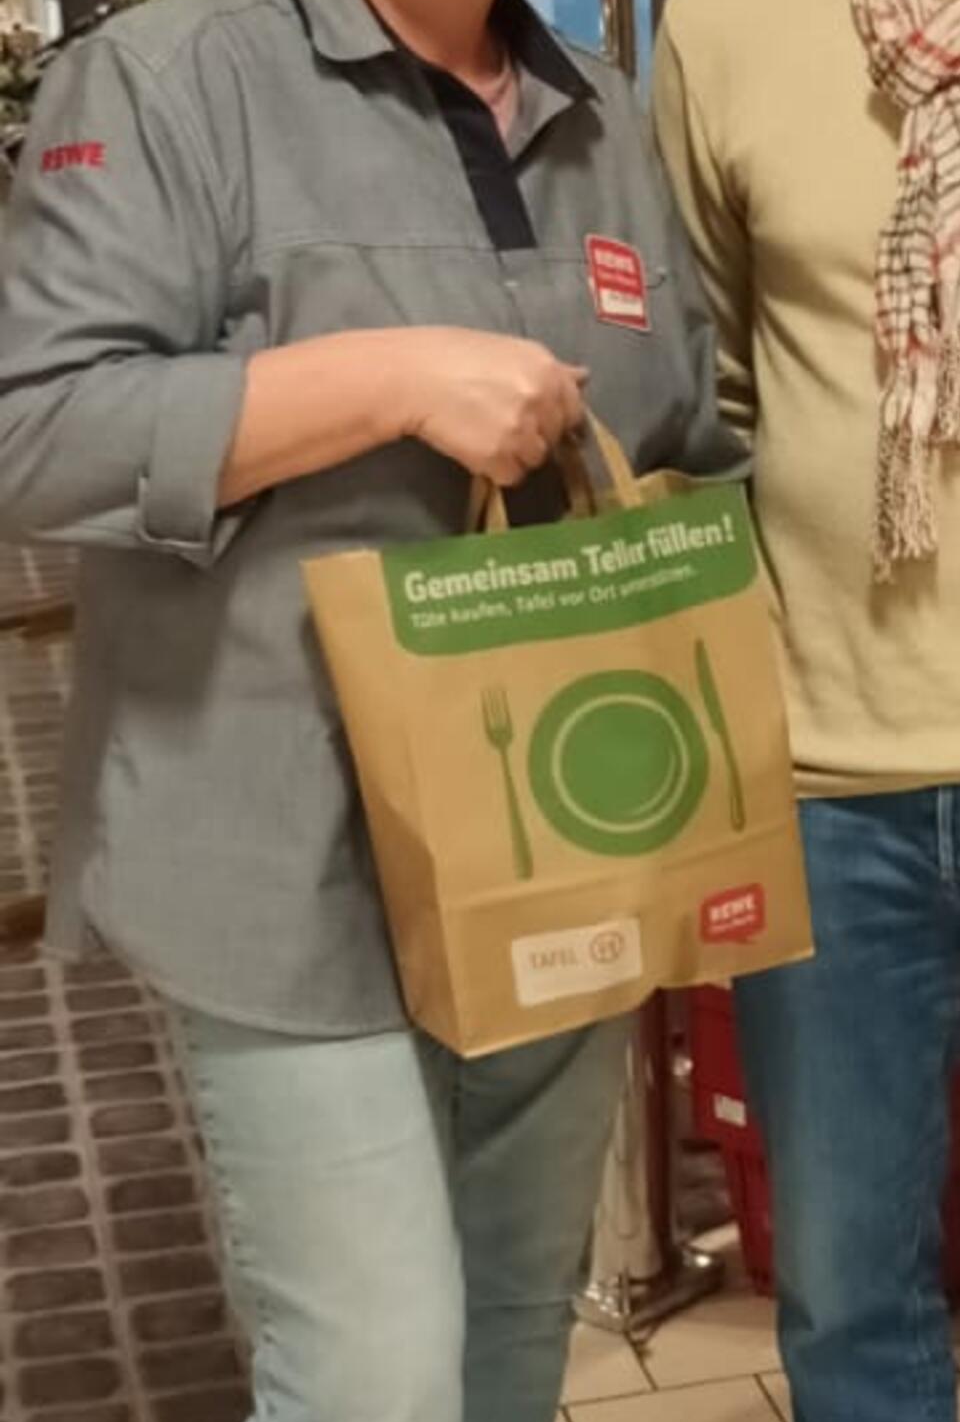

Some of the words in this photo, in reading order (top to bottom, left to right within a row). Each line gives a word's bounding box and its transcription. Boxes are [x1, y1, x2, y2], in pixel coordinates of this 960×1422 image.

[42, 141, 104, 173] REWE
[404, 558, 578, 604] Gemeinsam
[647, 512, 736, 560] füllen!
[515, 592, 555, 614] Tafel
[558, 590, 585, 607] vor
[588, 584, 617, 604] Ort
[528, 945, 580, 970] TAFEL
